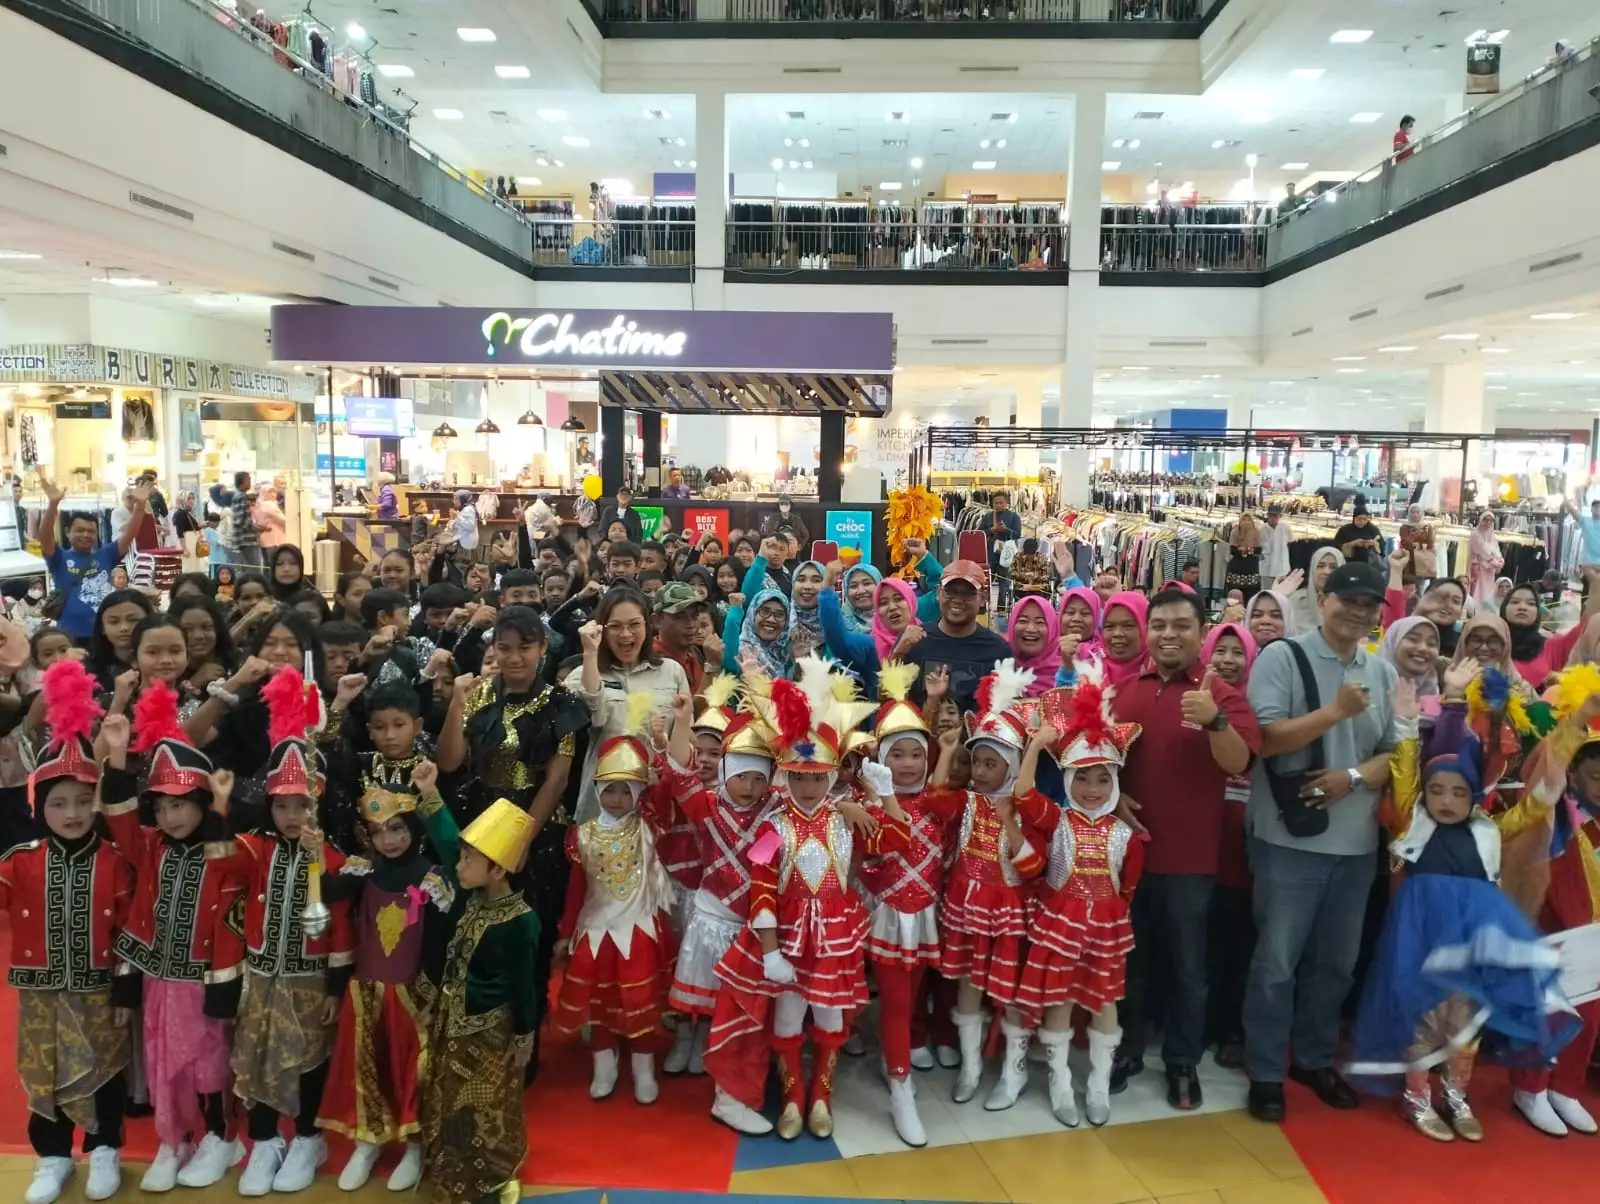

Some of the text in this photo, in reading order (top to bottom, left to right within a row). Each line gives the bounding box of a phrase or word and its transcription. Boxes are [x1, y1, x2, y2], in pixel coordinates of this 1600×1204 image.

[520, 313, 687, 356] Chatime
[0, 356, 45, 369] CTION
[229, 369, 289, 393] COLLECTION
[877, 427, 922, 439] IMPERIA
[695, 515, 718, 523] BEST
[835, 523, 865, 532] CHOC
